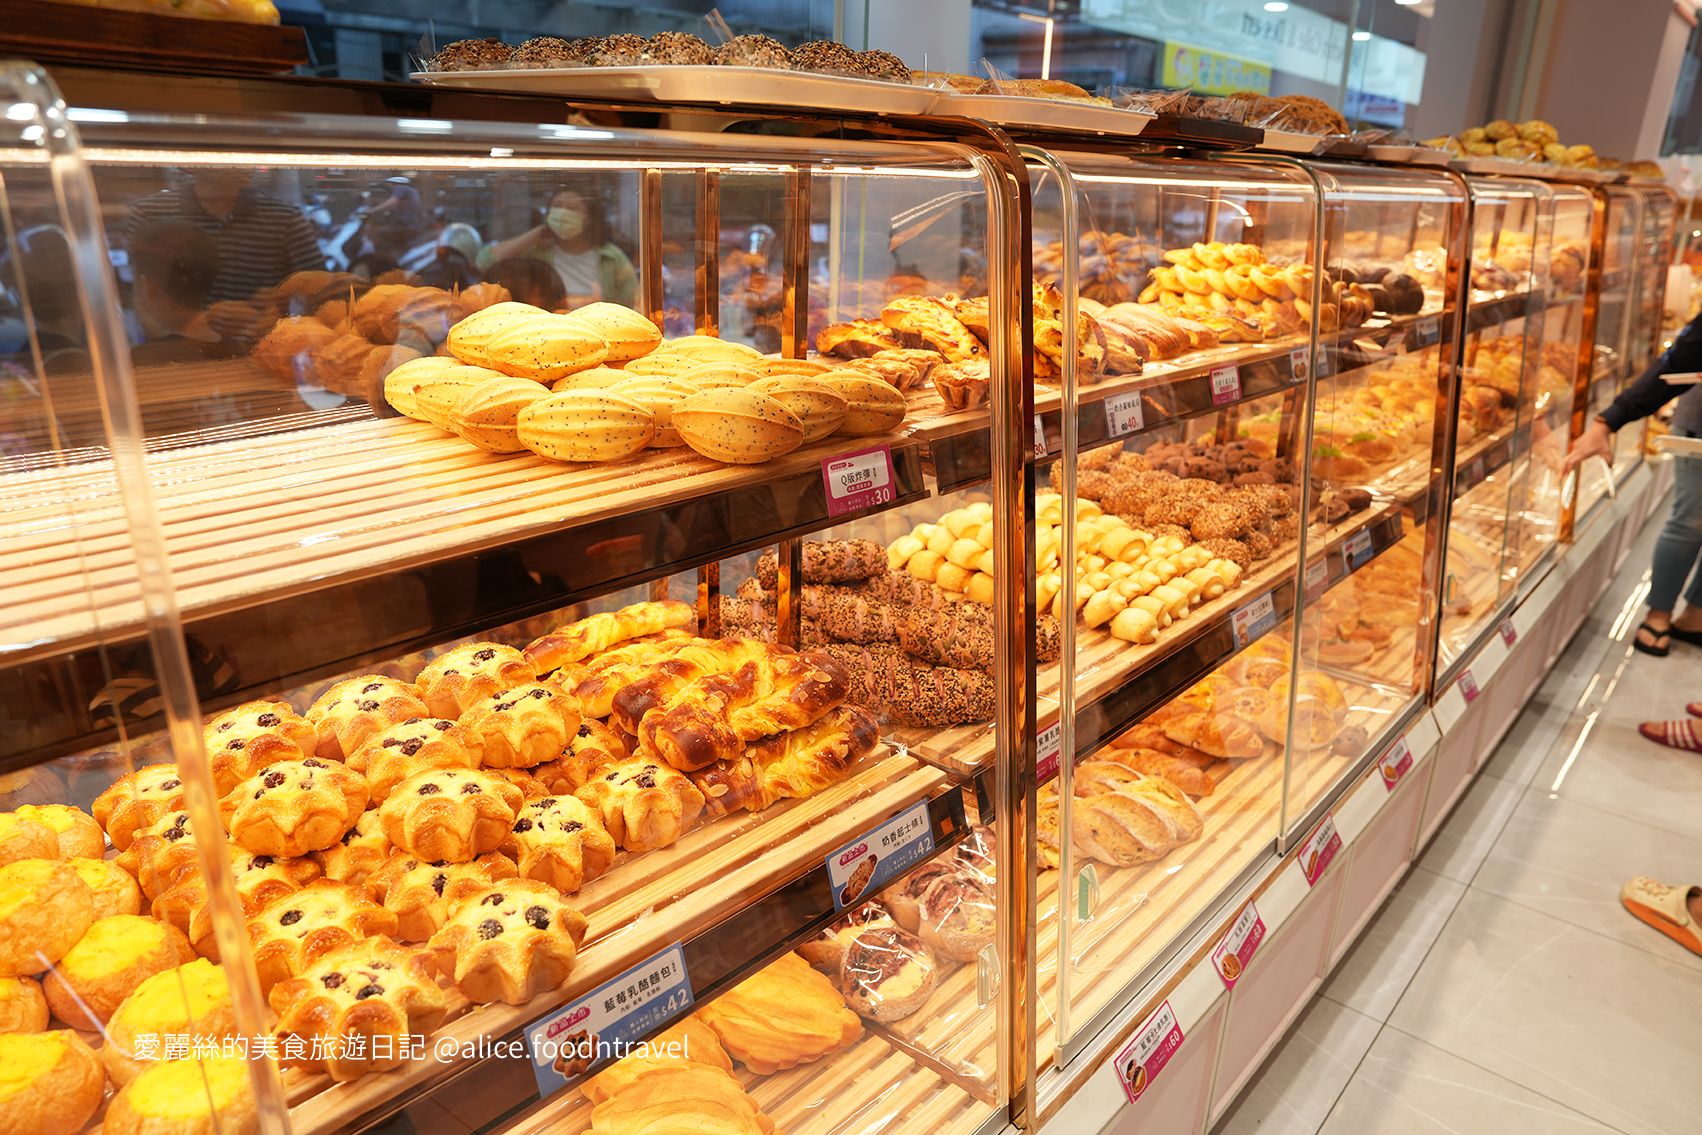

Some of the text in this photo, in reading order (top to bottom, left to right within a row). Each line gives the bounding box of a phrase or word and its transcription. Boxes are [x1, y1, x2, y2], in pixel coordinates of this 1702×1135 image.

[841, 468, 870, 486] Q版炸彈
[871, 488, 890, 505] $30
[881, 818, 918, 847] 奶香起士條
[913, 837, 932, 858] $42
[603, 965, 672, 1013] 藍莓乳酪麵包
[661, 988, 689, 1016] $42
[549, 1006, 587, 1035] 新品上市
[1168, 1030, 1180, 1052] $60
